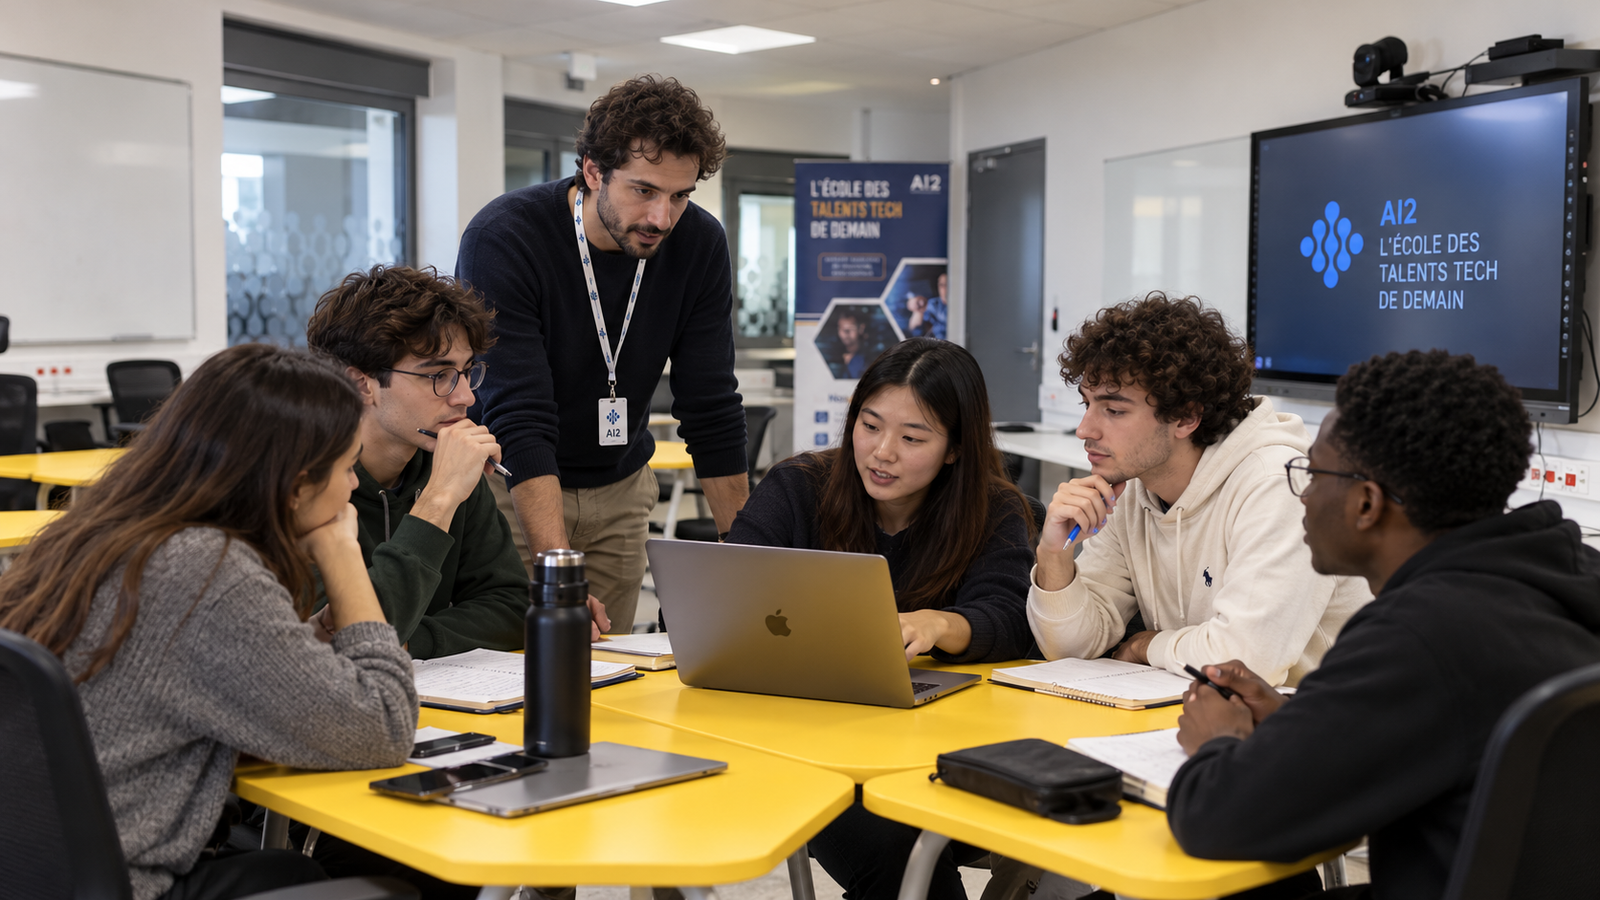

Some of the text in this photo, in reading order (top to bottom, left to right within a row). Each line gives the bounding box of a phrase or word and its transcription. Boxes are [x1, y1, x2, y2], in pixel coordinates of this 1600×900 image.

[810, 177, 890, 198] L'ÉCOLE DES
[910, 174, 941, 192] AI2
[810, 201, 903, 218] TALENTS TECH
[1380, 198, 1417, 226] AI2
[810, 221, 880, 239] DE DEMAIN
[1380, 232, 1480, 256] L'ÉCOLE DES
[1379, 260, 1498, 282] TALENTS TECH
[1379, 289, 1464, 309] DE DEMAIN
[606, 428, 621, 438] AI2
